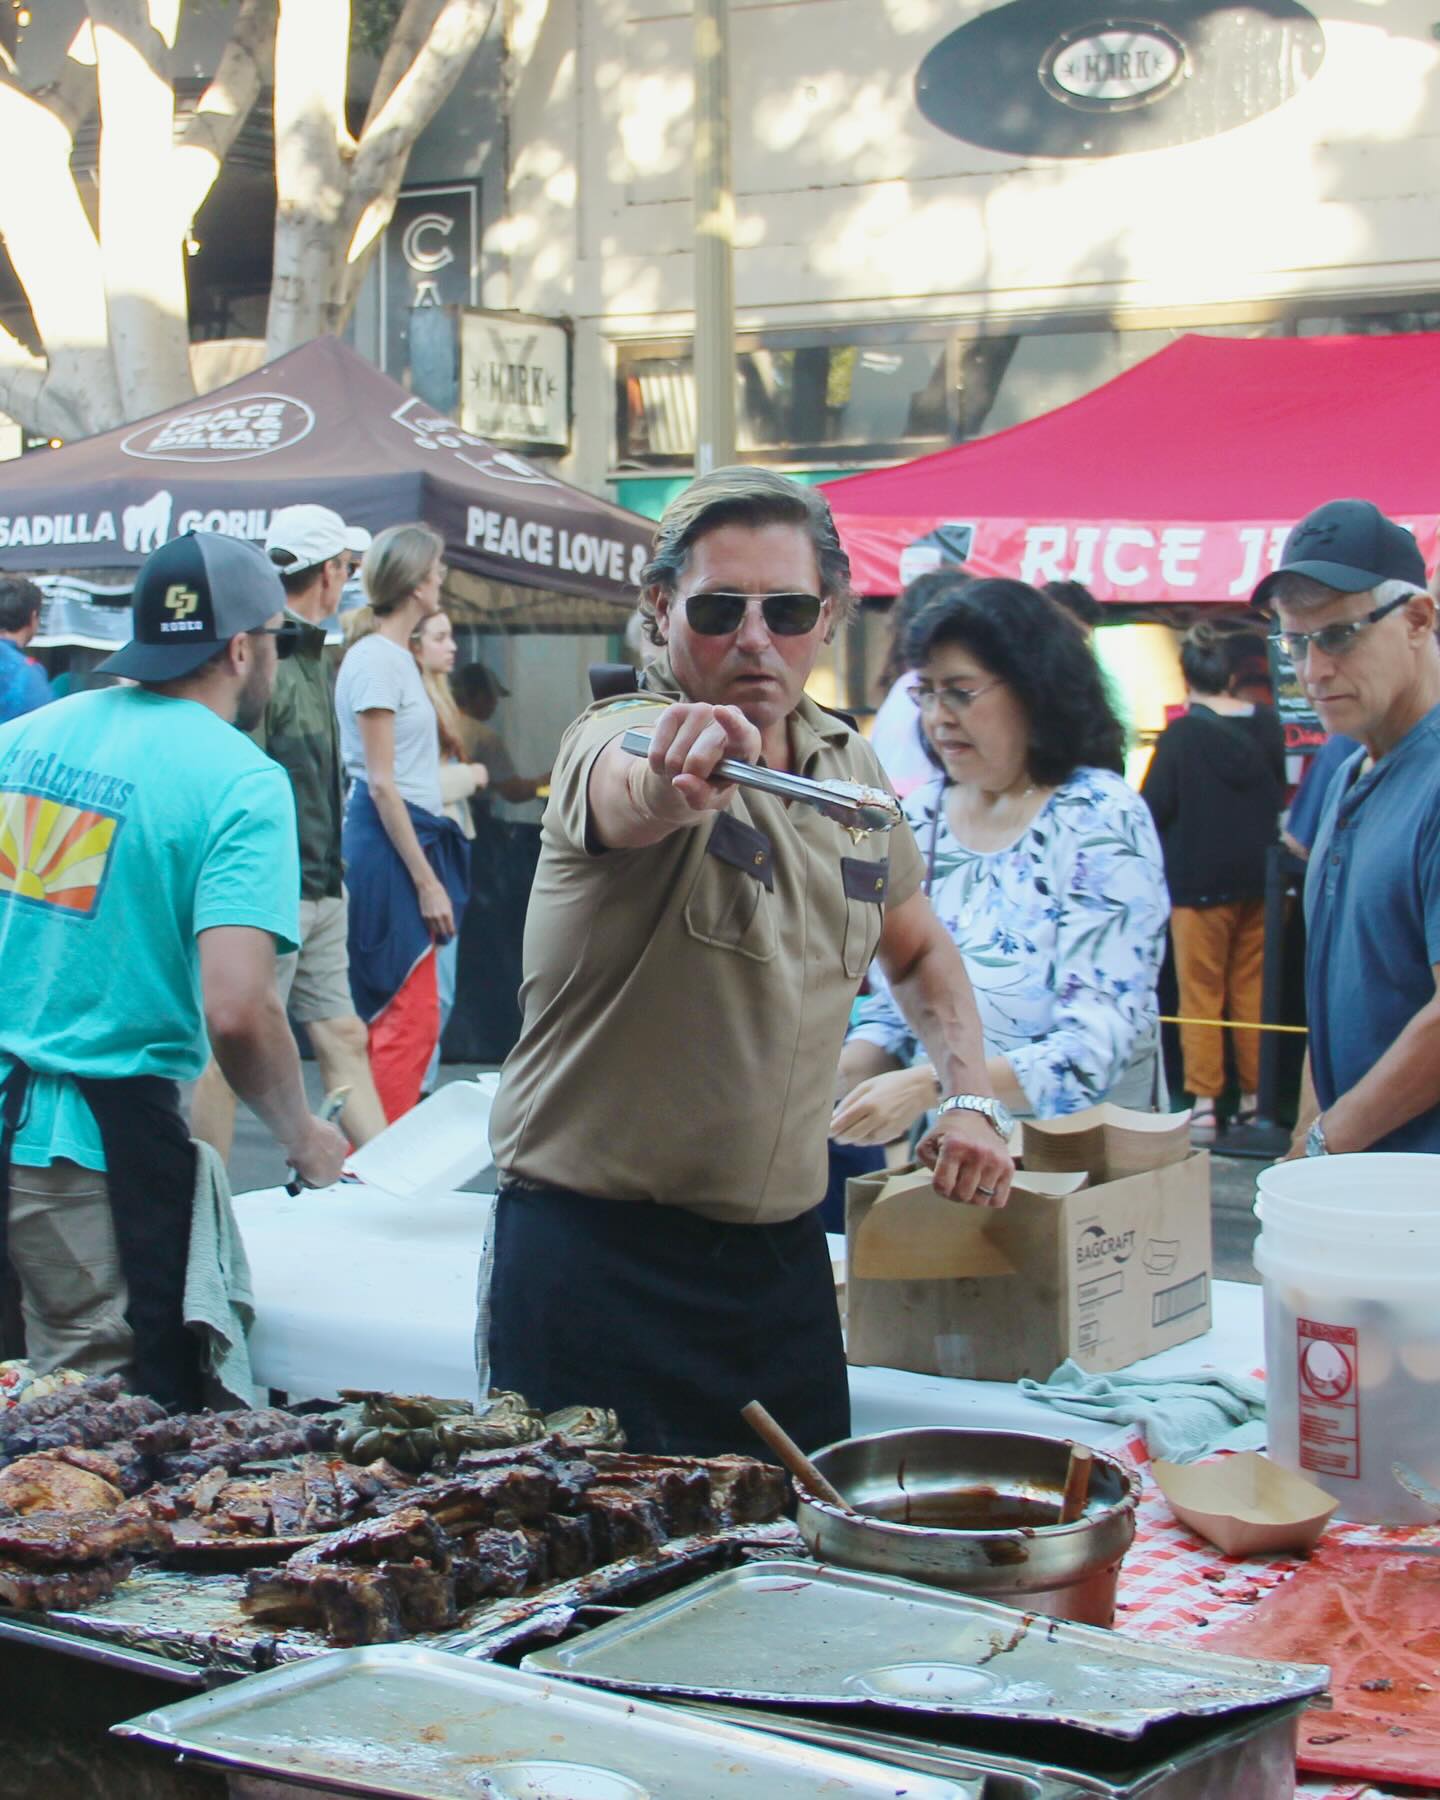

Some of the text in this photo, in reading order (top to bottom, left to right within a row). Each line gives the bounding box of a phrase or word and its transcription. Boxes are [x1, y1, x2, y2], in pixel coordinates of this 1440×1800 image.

[167, 402, 287, 429] PEACE
[465, 505, 554, 567] PEACE
[558, 530, 625, 582] LOVE
[1019, 526, 1206, 587] RICE
[1077, 1229, 1136, 1264] BAGCRAFT
